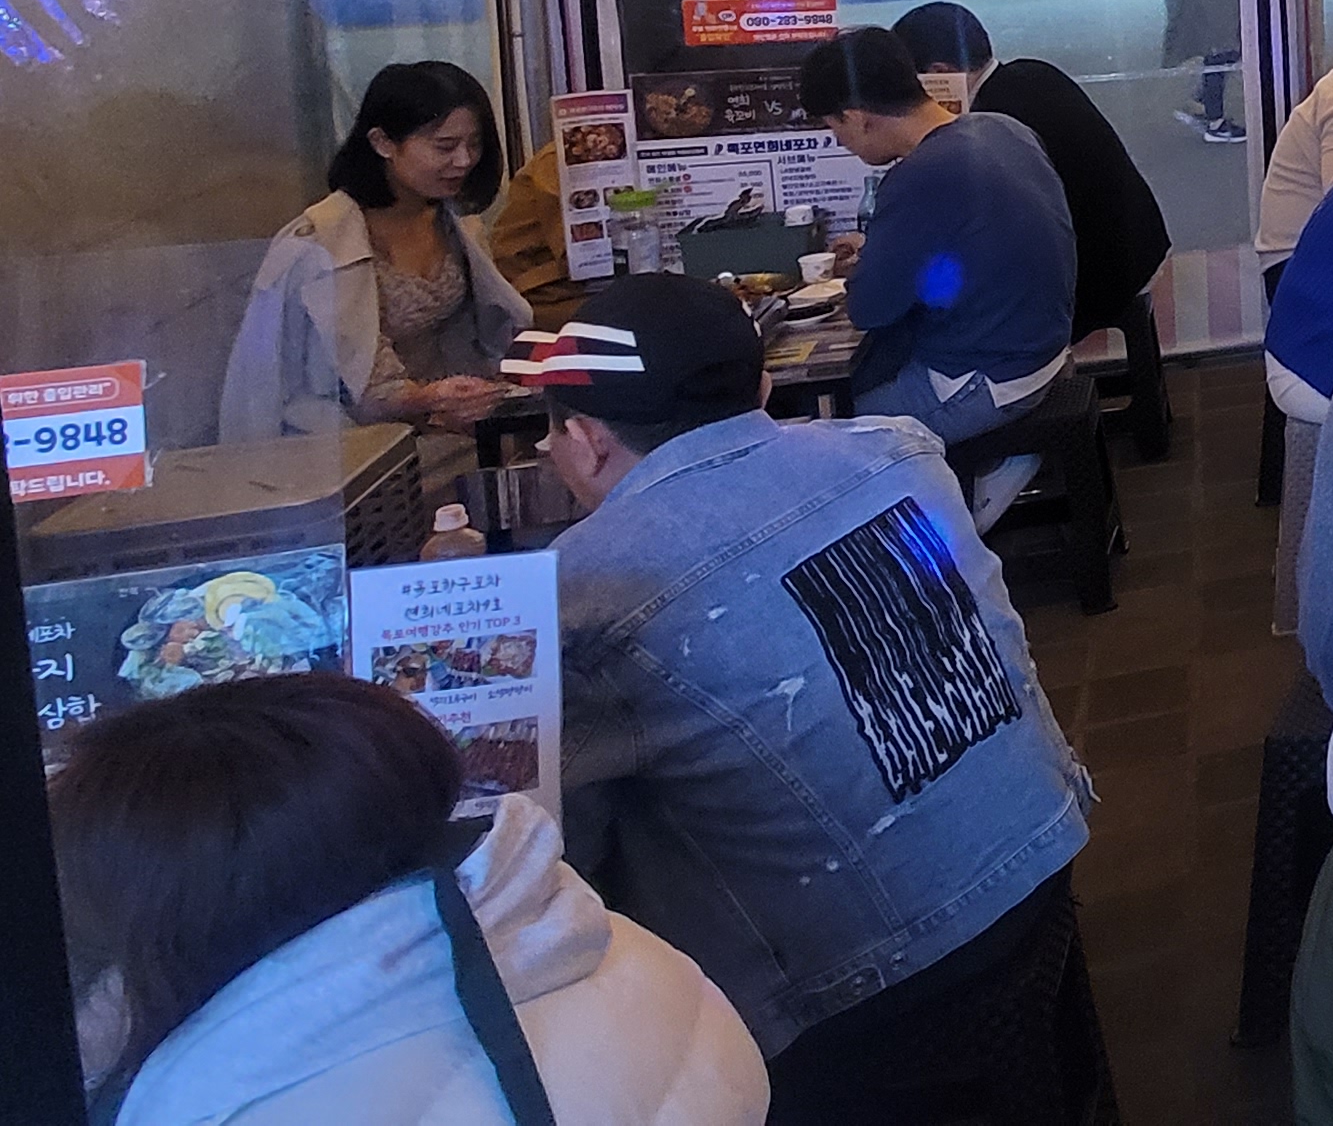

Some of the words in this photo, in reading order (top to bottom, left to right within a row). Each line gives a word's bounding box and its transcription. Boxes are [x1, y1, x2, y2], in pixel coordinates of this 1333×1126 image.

[764, 99, 783, 116] VS
[458, 619, 481, 633] 인기
[486, 617, 511, 630] TOP
[513, 616, 522, 626] 3
